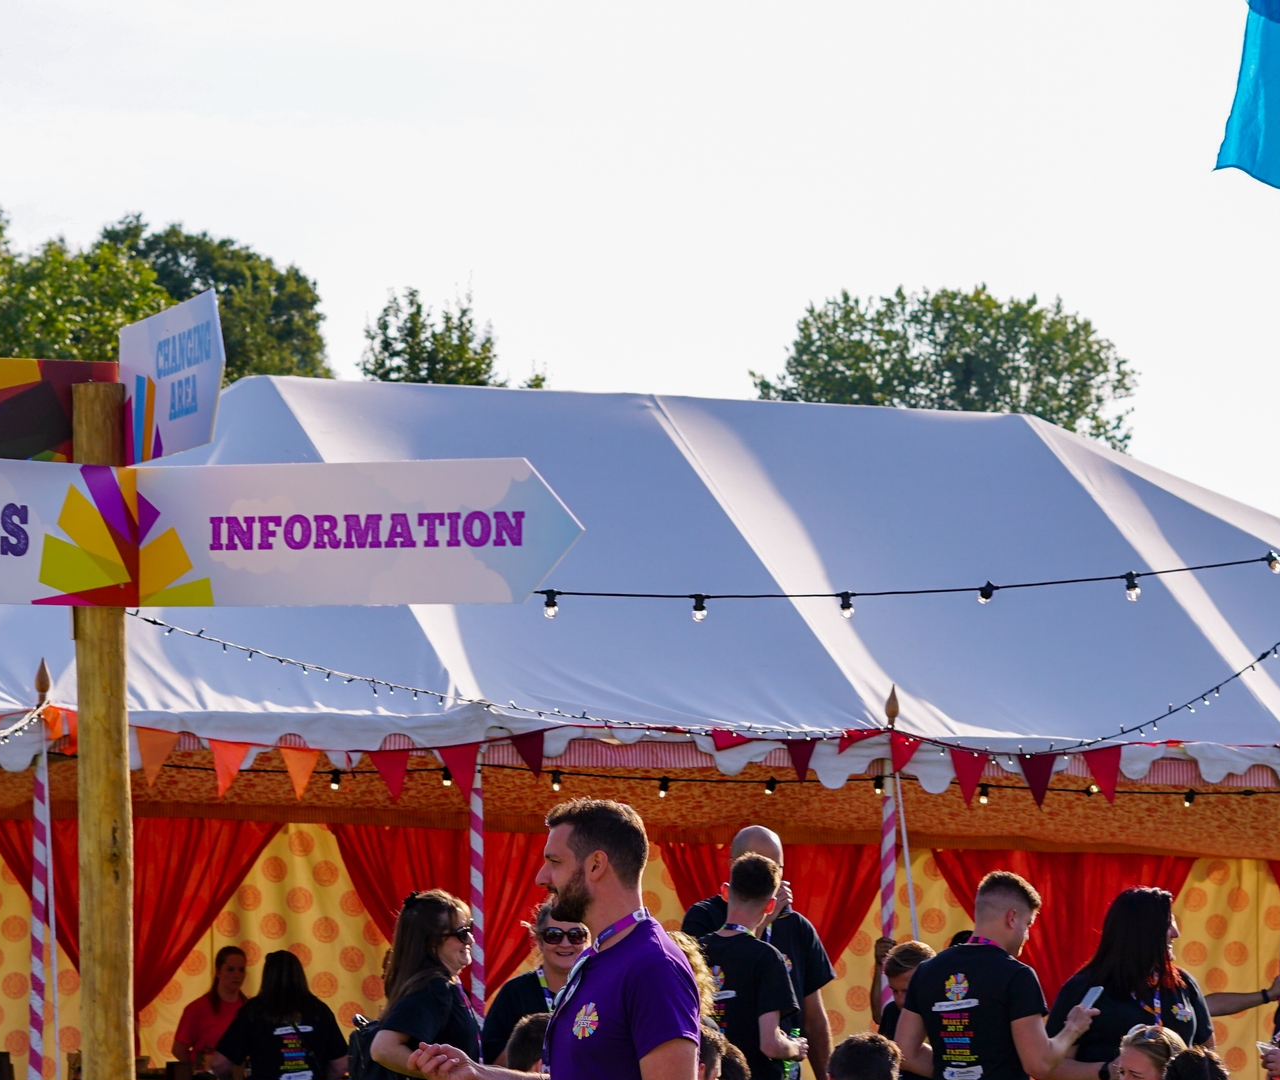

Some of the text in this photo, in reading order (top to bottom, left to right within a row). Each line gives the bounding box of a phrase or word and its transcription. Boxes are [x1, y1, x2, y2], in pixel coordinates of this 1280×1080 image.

[156, 321, 211, 379] CHANGING
[169, 374, 198, 421] AREA
[209, 511, 525, 550] INFORMATION
